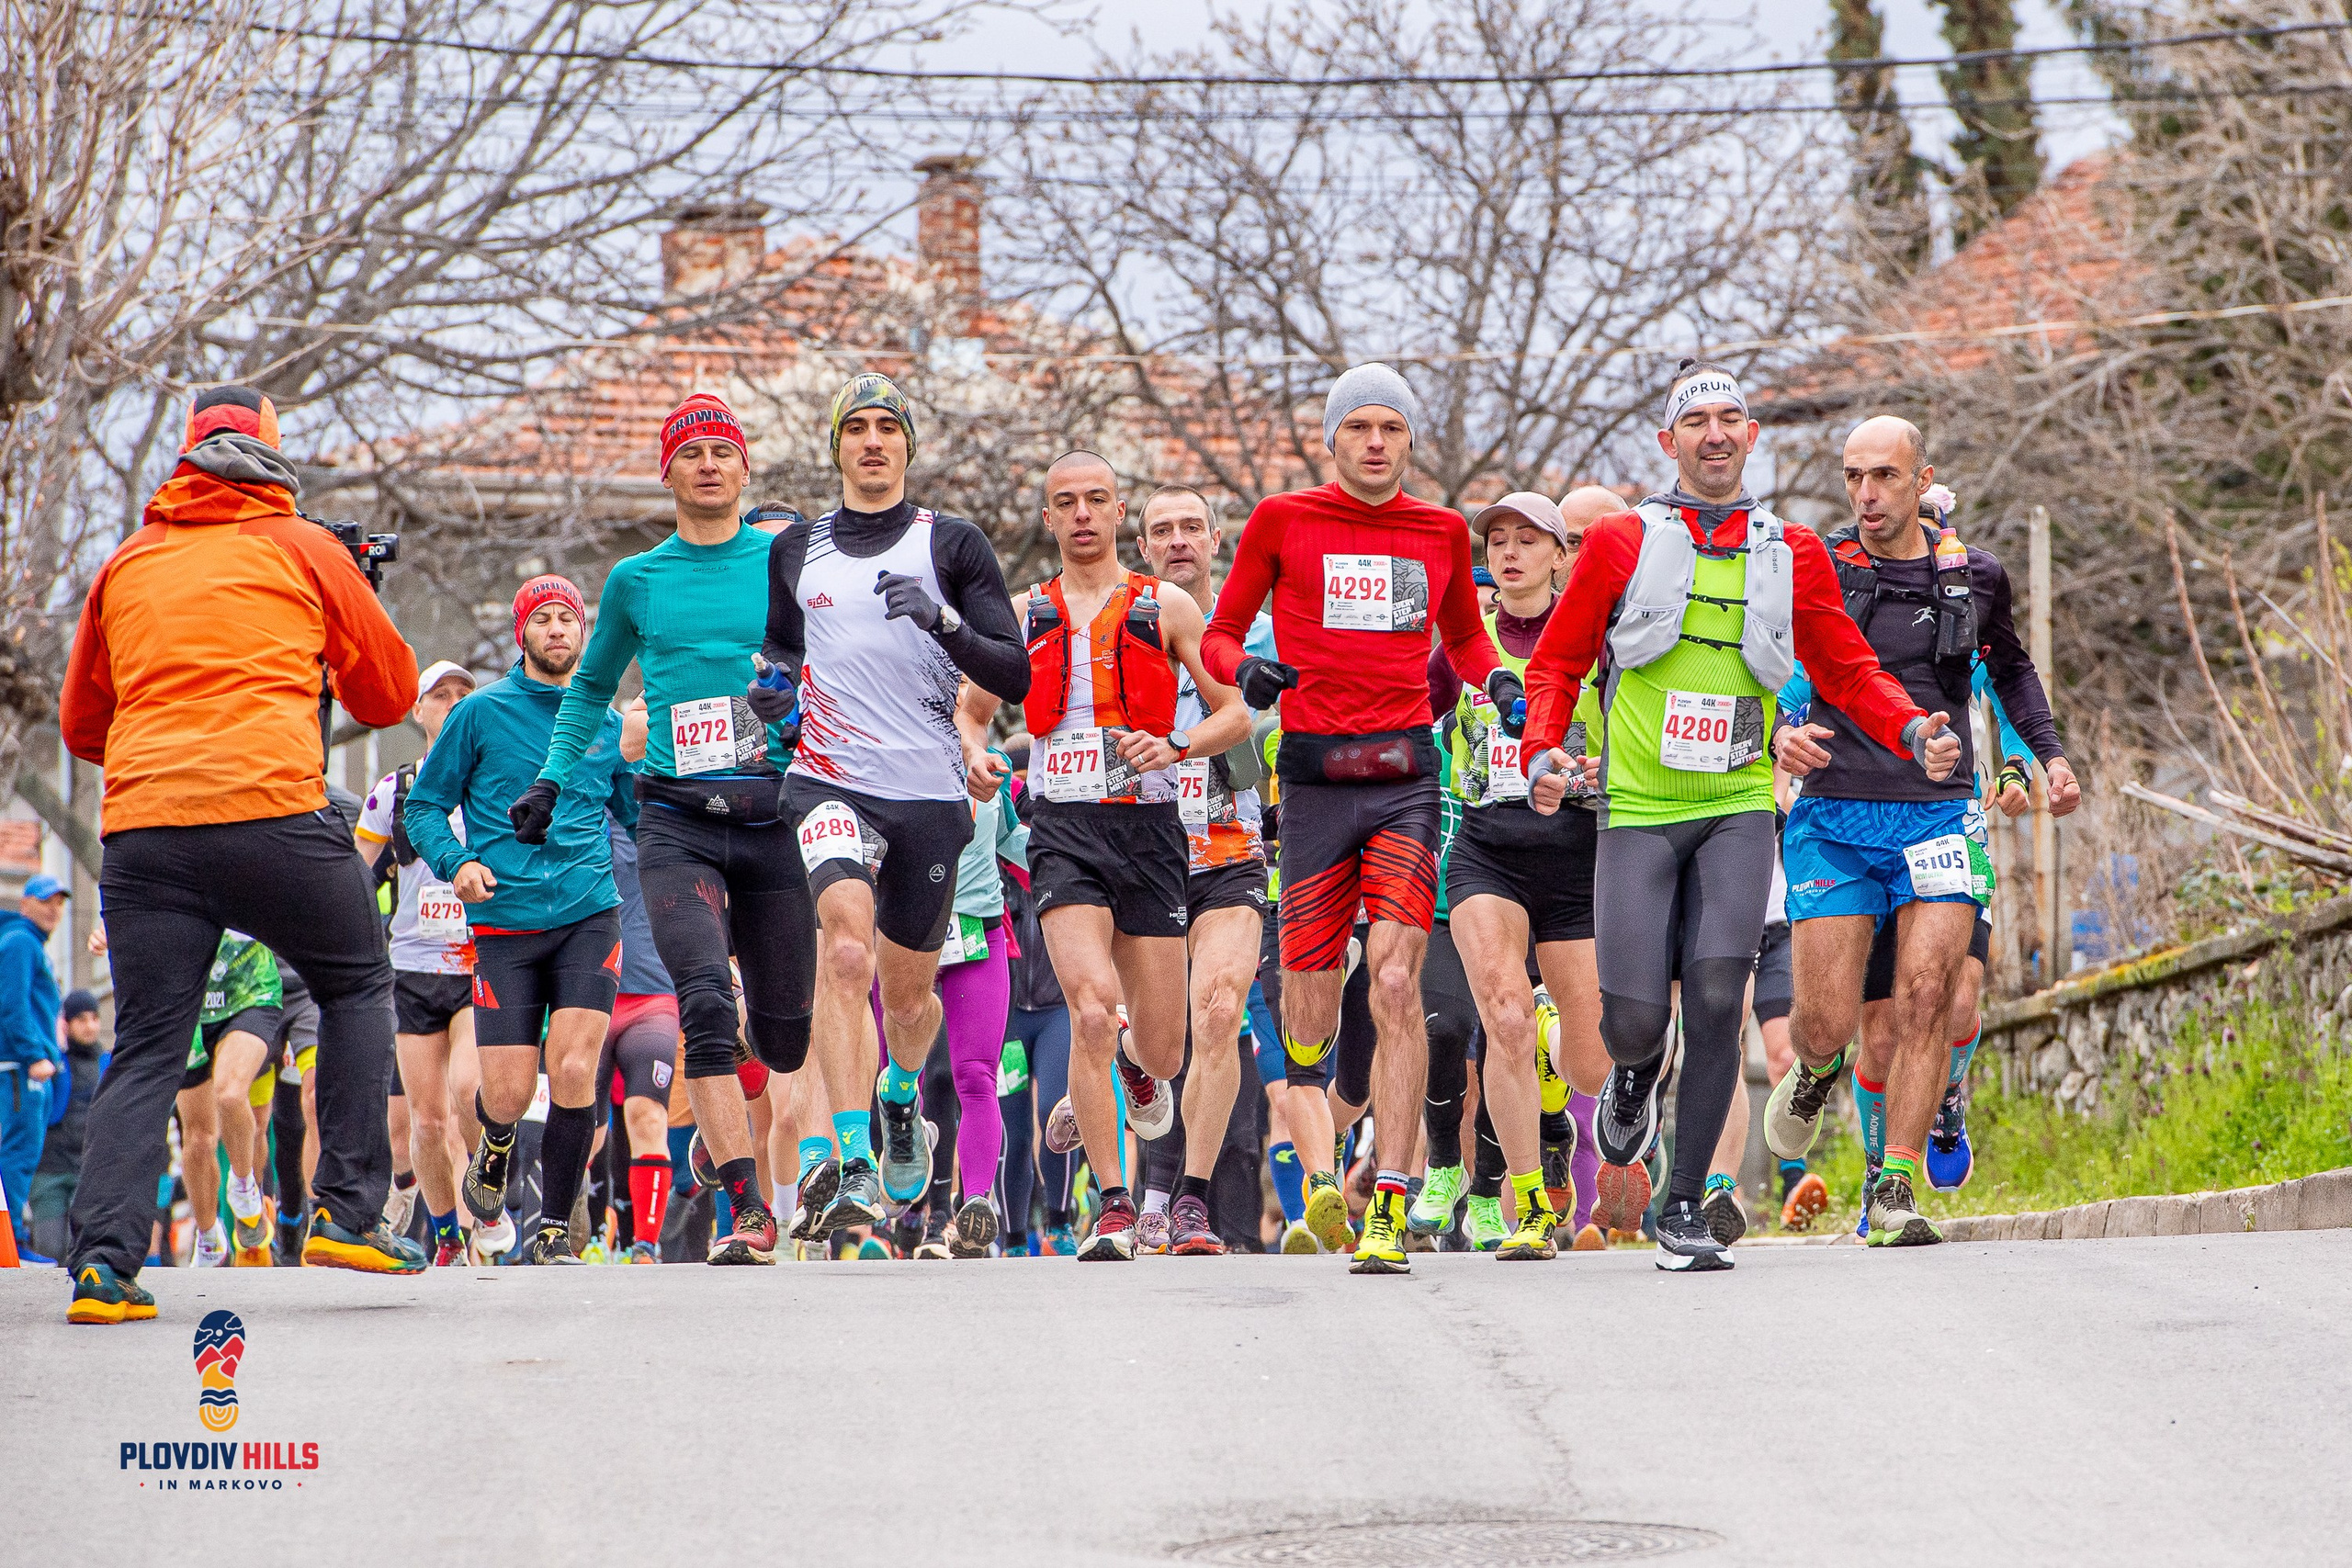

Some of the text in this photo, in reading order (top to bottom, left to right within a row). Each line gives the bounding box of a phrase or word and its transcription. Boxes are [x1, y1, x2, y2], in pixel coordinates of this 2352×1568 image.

[1678, 381, 1731, 405] KIPRUN
[1357, 558, 1372, 567] 44K
[1328, 576, 1386, 601] 4292
[698, 702, 712, 711] 44K
[1701, 698, 1716, 707] 44K
[676, 718, 729, 748] 4272
[1071, 732, 1084, 740] 44K
[1665, 714, 1728, 744] 4280
[1046, 749, 1099, 775] 4277
[1490, 745, 1517, 769] 42
[1180, 777, 1203, 798] 75
[802, 818, 855, 845] 4289
[1936, 839, 1950, 847] 44K
[1914, 850, 1964, 870] 4105
[420, 901, 463, 919] 4279
[205, 990, 225, 1010] 2021
